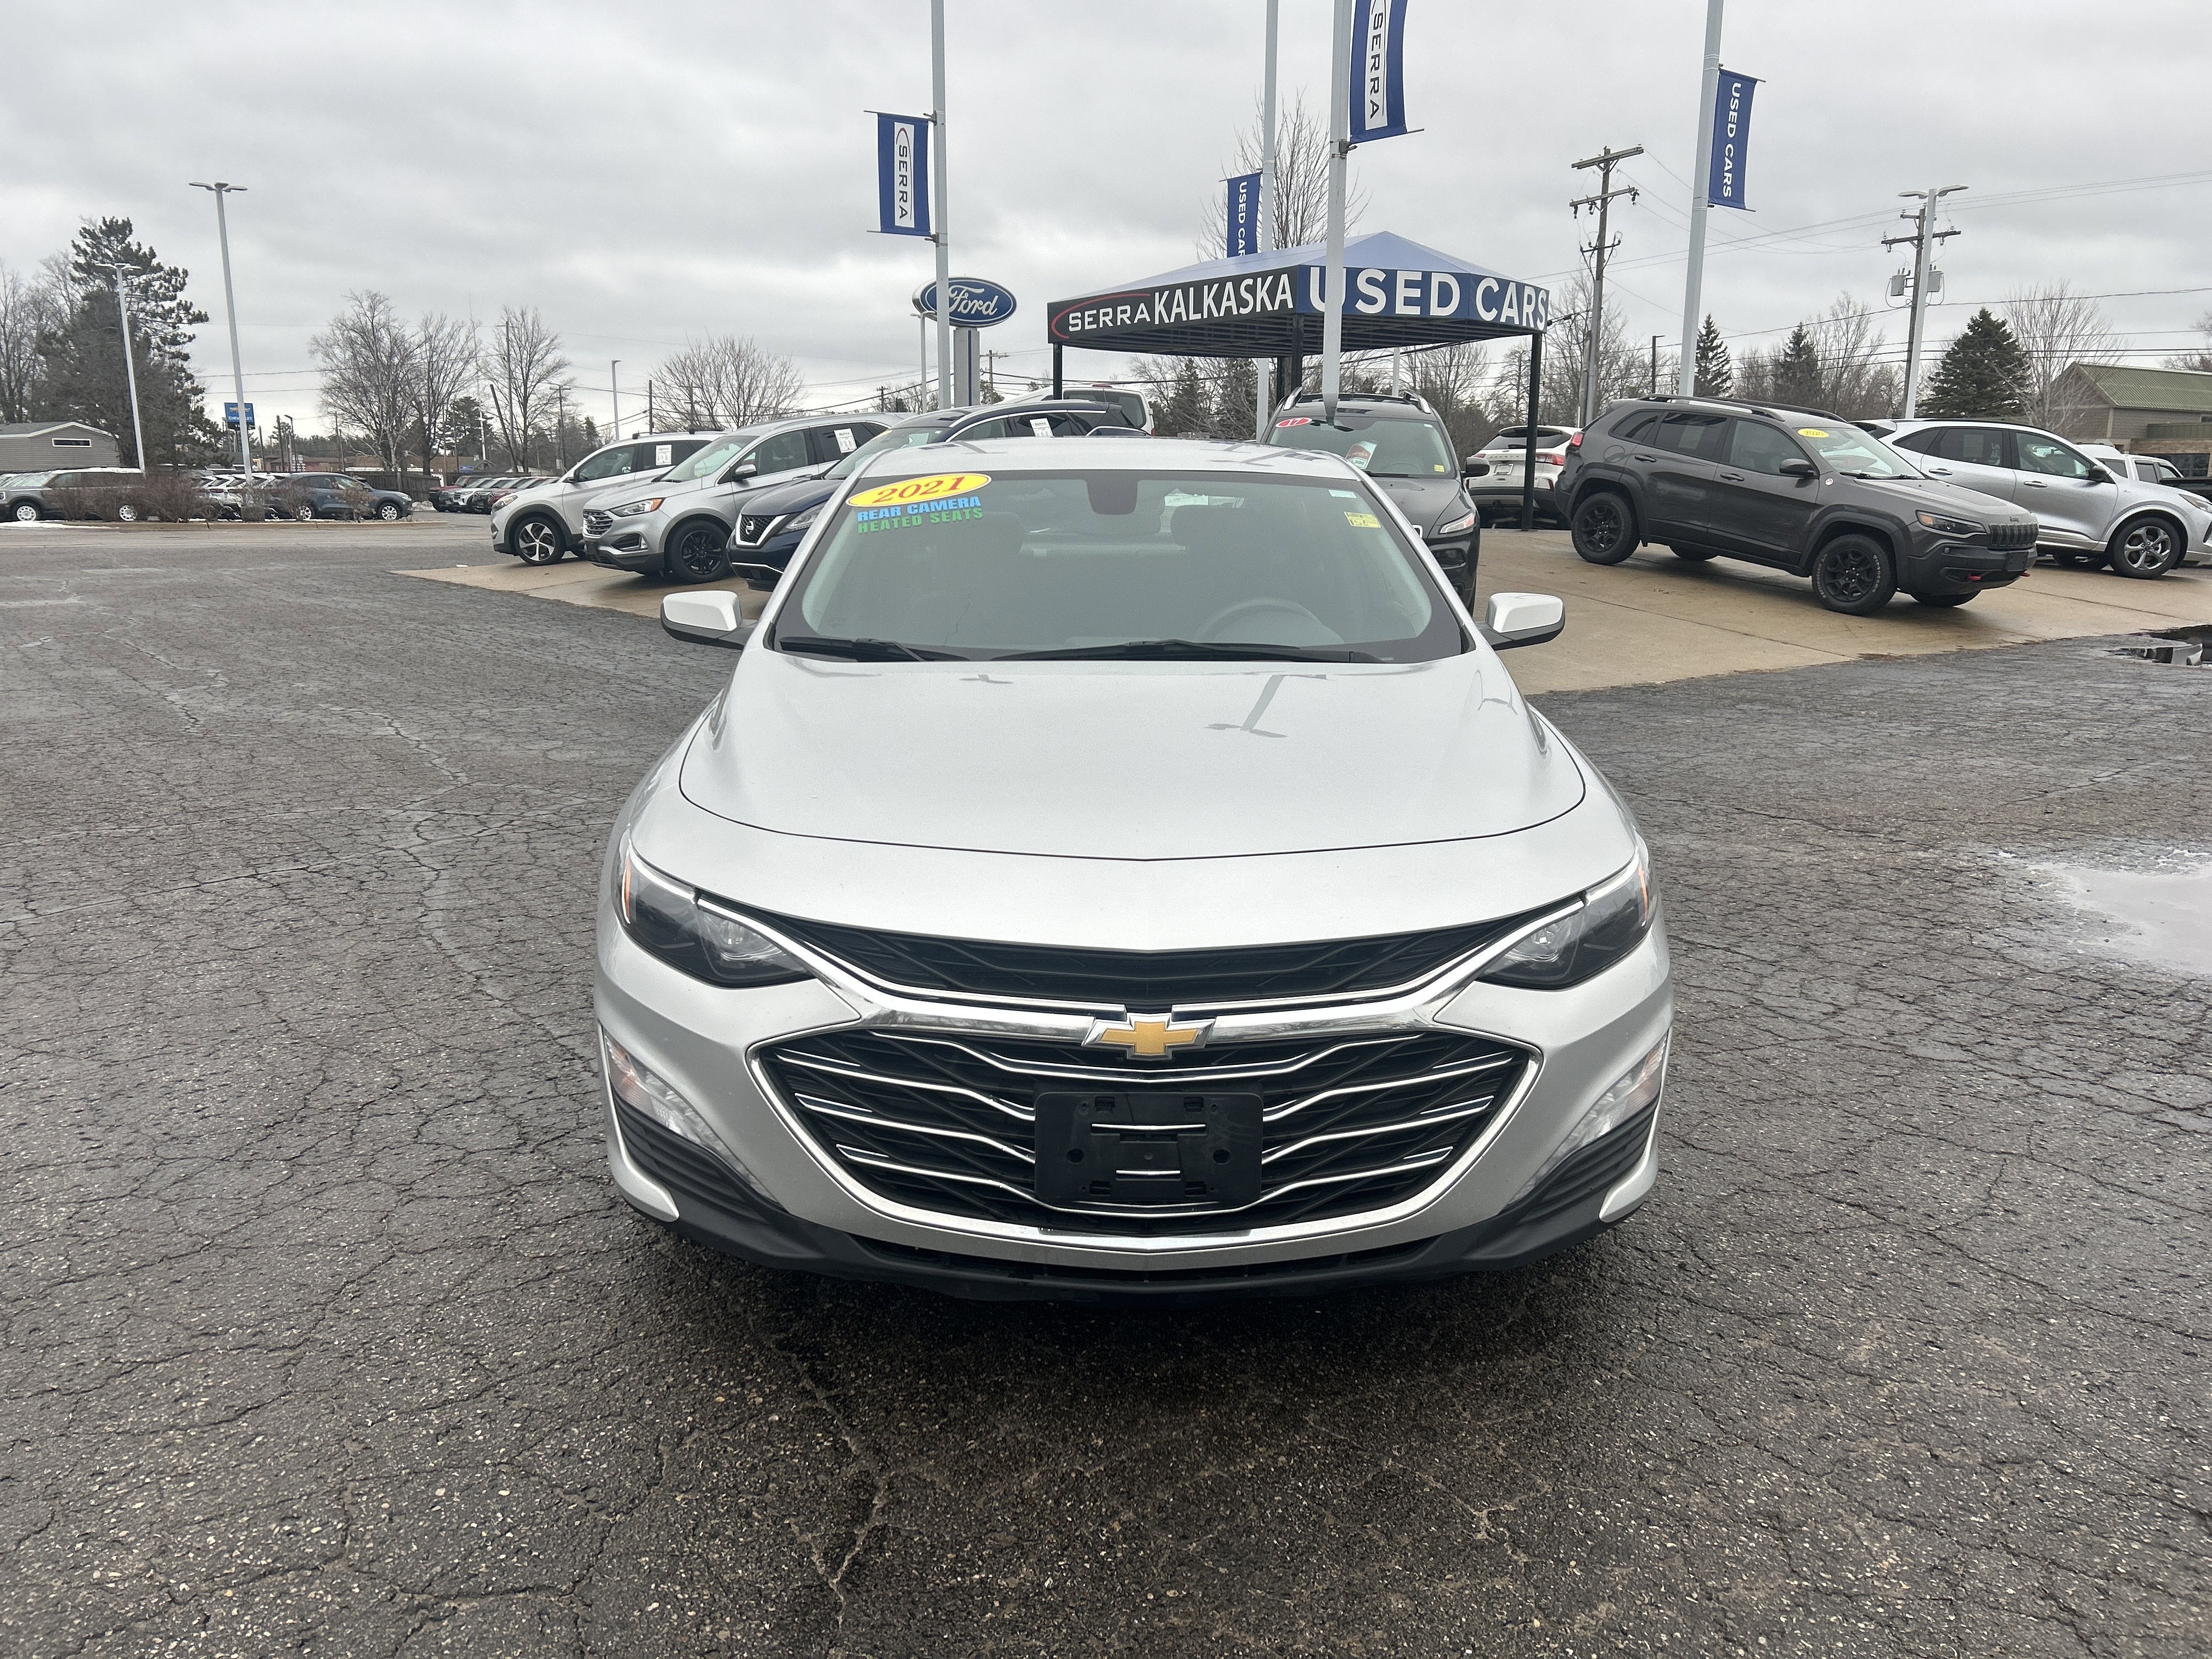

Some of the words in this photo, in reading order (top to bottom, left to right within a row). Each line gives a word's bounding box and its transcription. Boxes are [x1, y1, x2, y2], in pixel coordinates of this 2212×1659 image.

[1370, 12, 1383, 119] SERRA
[1727, 82, 1741, 138] USED
[898, 145, 908, 220] SERRA
[1723, 143, 1734, 198] CARS
[1238, 181, 1247, 224] USED
[949, 285, 998, 315] Ford
[1069, 302, 1150, 331] SERRA
[1155, 273, 1293, 324] KALKASKA
[1310, 267, 1460, 316] USED
[1476, 278, 1547, 331] CARS
[857, 506, 902, 522] REAR
[907, 496, 981, 515] CAMERA
[872, 476, 965, 504] 2021
[857, 515, 922, 534] HEATED
[930, 507, 984, 524] SEATS
